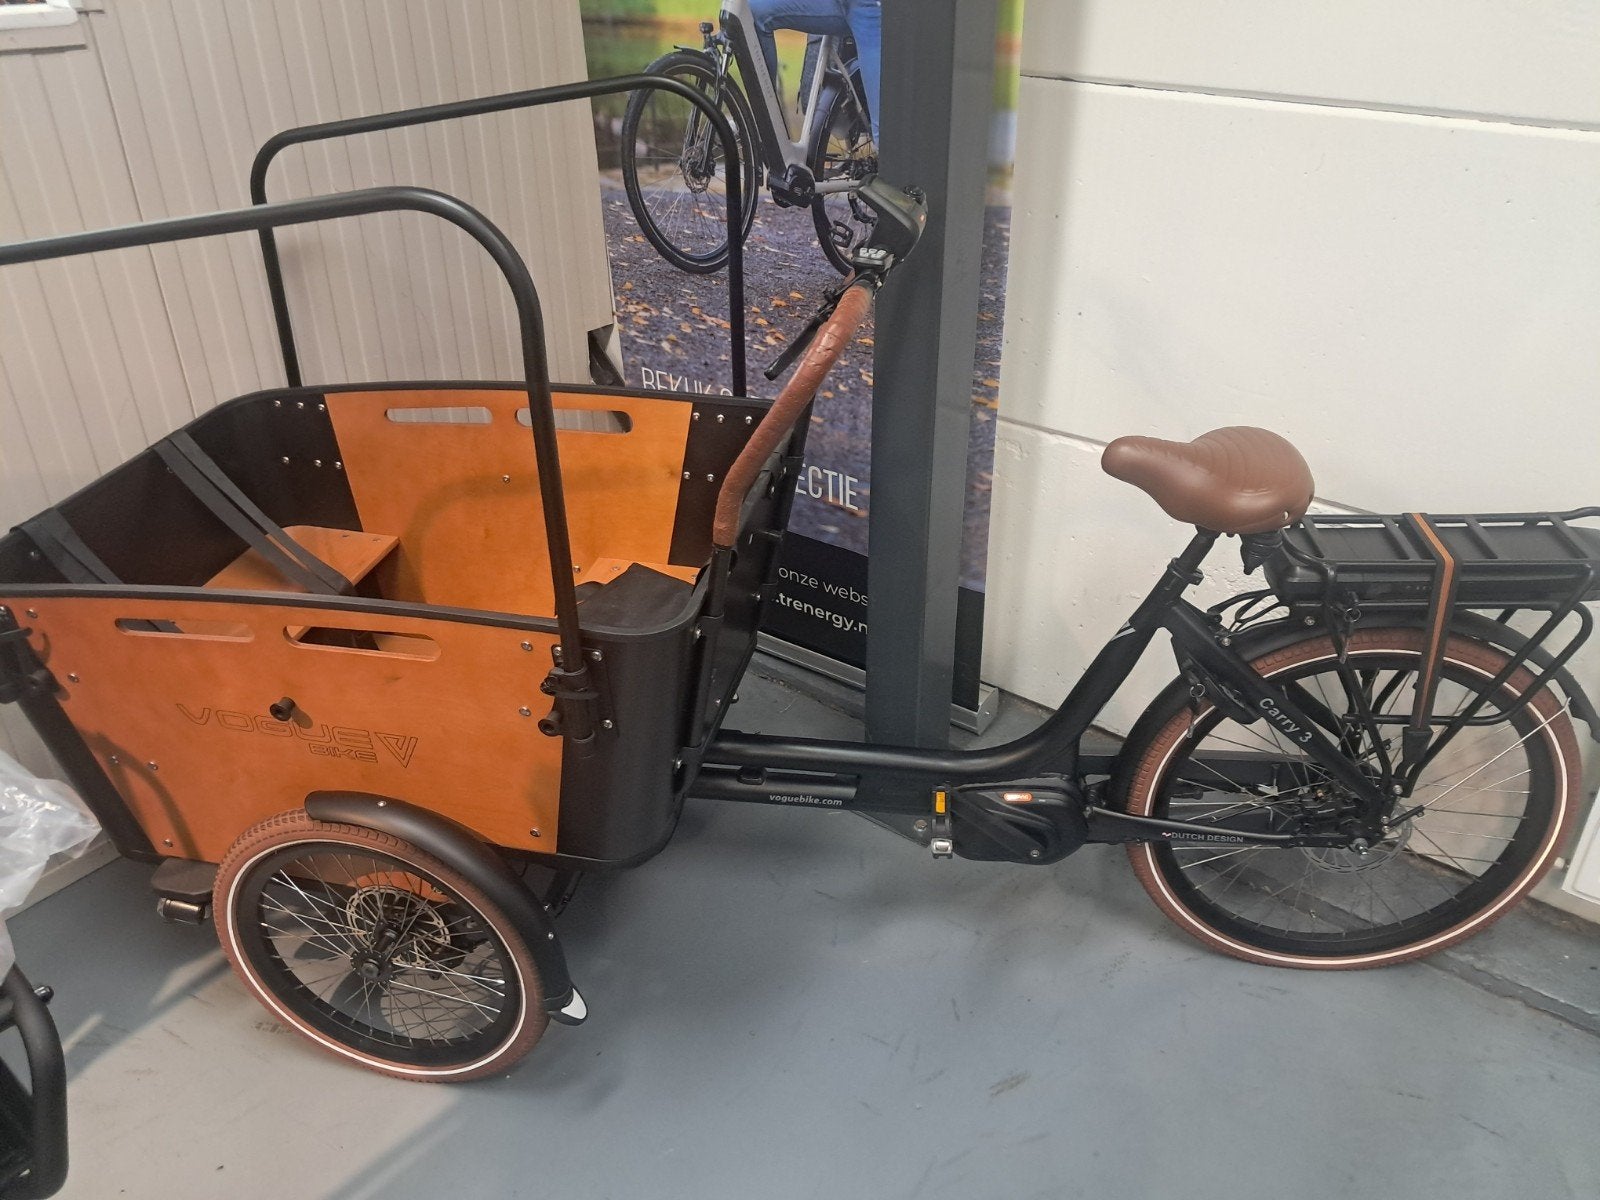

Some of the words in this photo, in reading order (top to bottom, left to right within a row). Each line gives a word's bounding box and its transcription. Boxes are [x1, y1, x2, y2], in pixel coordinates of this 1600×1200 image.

[778, 567, 818, 589] onze
[176, 703, 374, 750] VOGUE
[1259, 697, 1300, 733] Carry
[1299, 731, 1312, 743] 3
[308, 743, 379, 764] BIKE
[769, 794, 843, 806] voguebike.com
[1171, 831, 1205, 841] DUTCH
[1206, 834, 1244, 843] DESIGN
